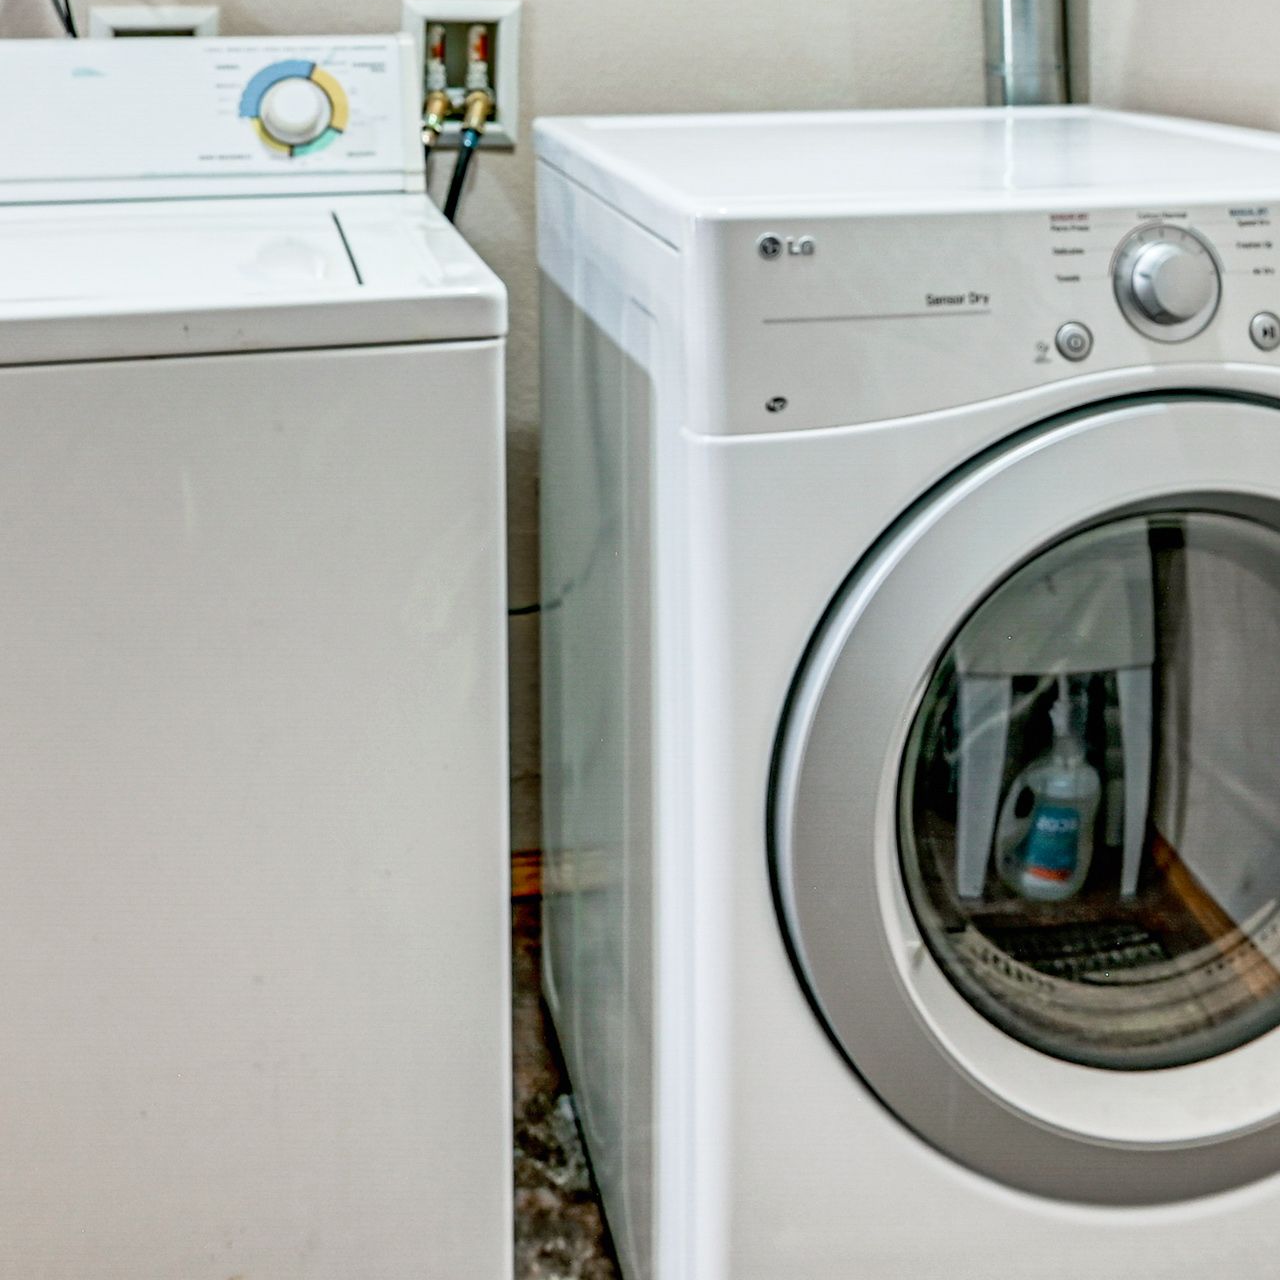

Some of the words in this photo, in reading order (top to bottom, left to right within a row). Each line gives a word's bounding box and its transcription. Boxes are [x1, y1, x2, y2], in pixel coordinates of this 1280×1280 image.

[786, 236, 815, 256] LG
[925, 293, 966, 307] Sensor
[968, 290, 991, 307] Dry
